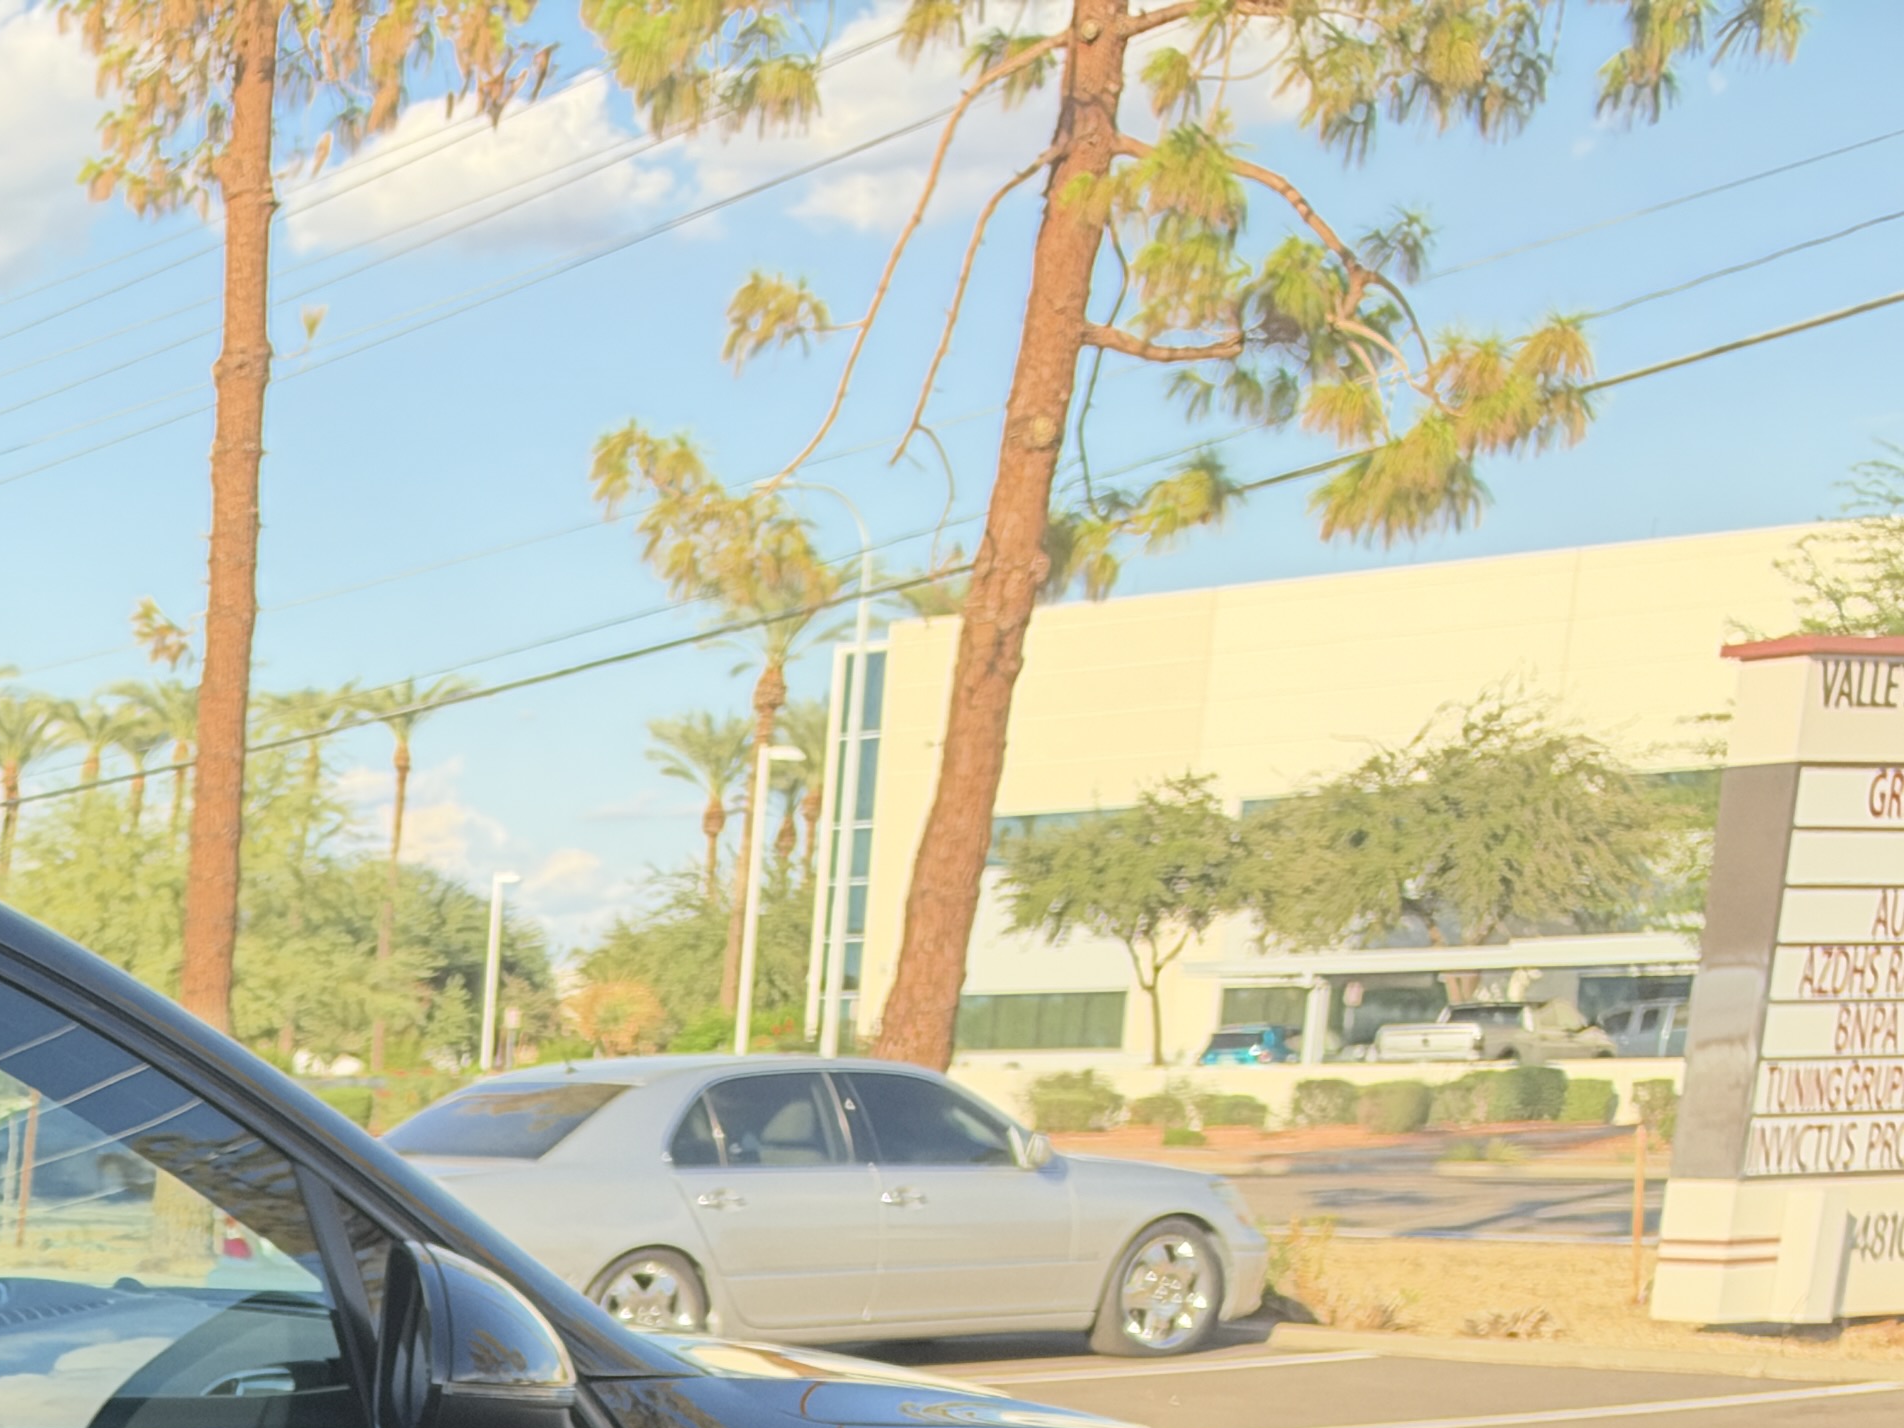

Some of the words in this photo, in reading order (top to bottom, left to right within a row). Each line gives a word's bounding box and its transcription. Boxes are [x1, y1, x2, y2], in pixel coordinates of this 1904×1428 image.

[1821, 659, 1904, 708] VALLE
[1798, 945, 1881, 996] AZDHS
[1885, 946, 1904, 995] R
[1834, 1002, 1898, 1054] BNPA
[1766, 1062, 1904, 1113] TUNINGGRUP
[1746, 1121, 1857, 1173] INVICTUS
